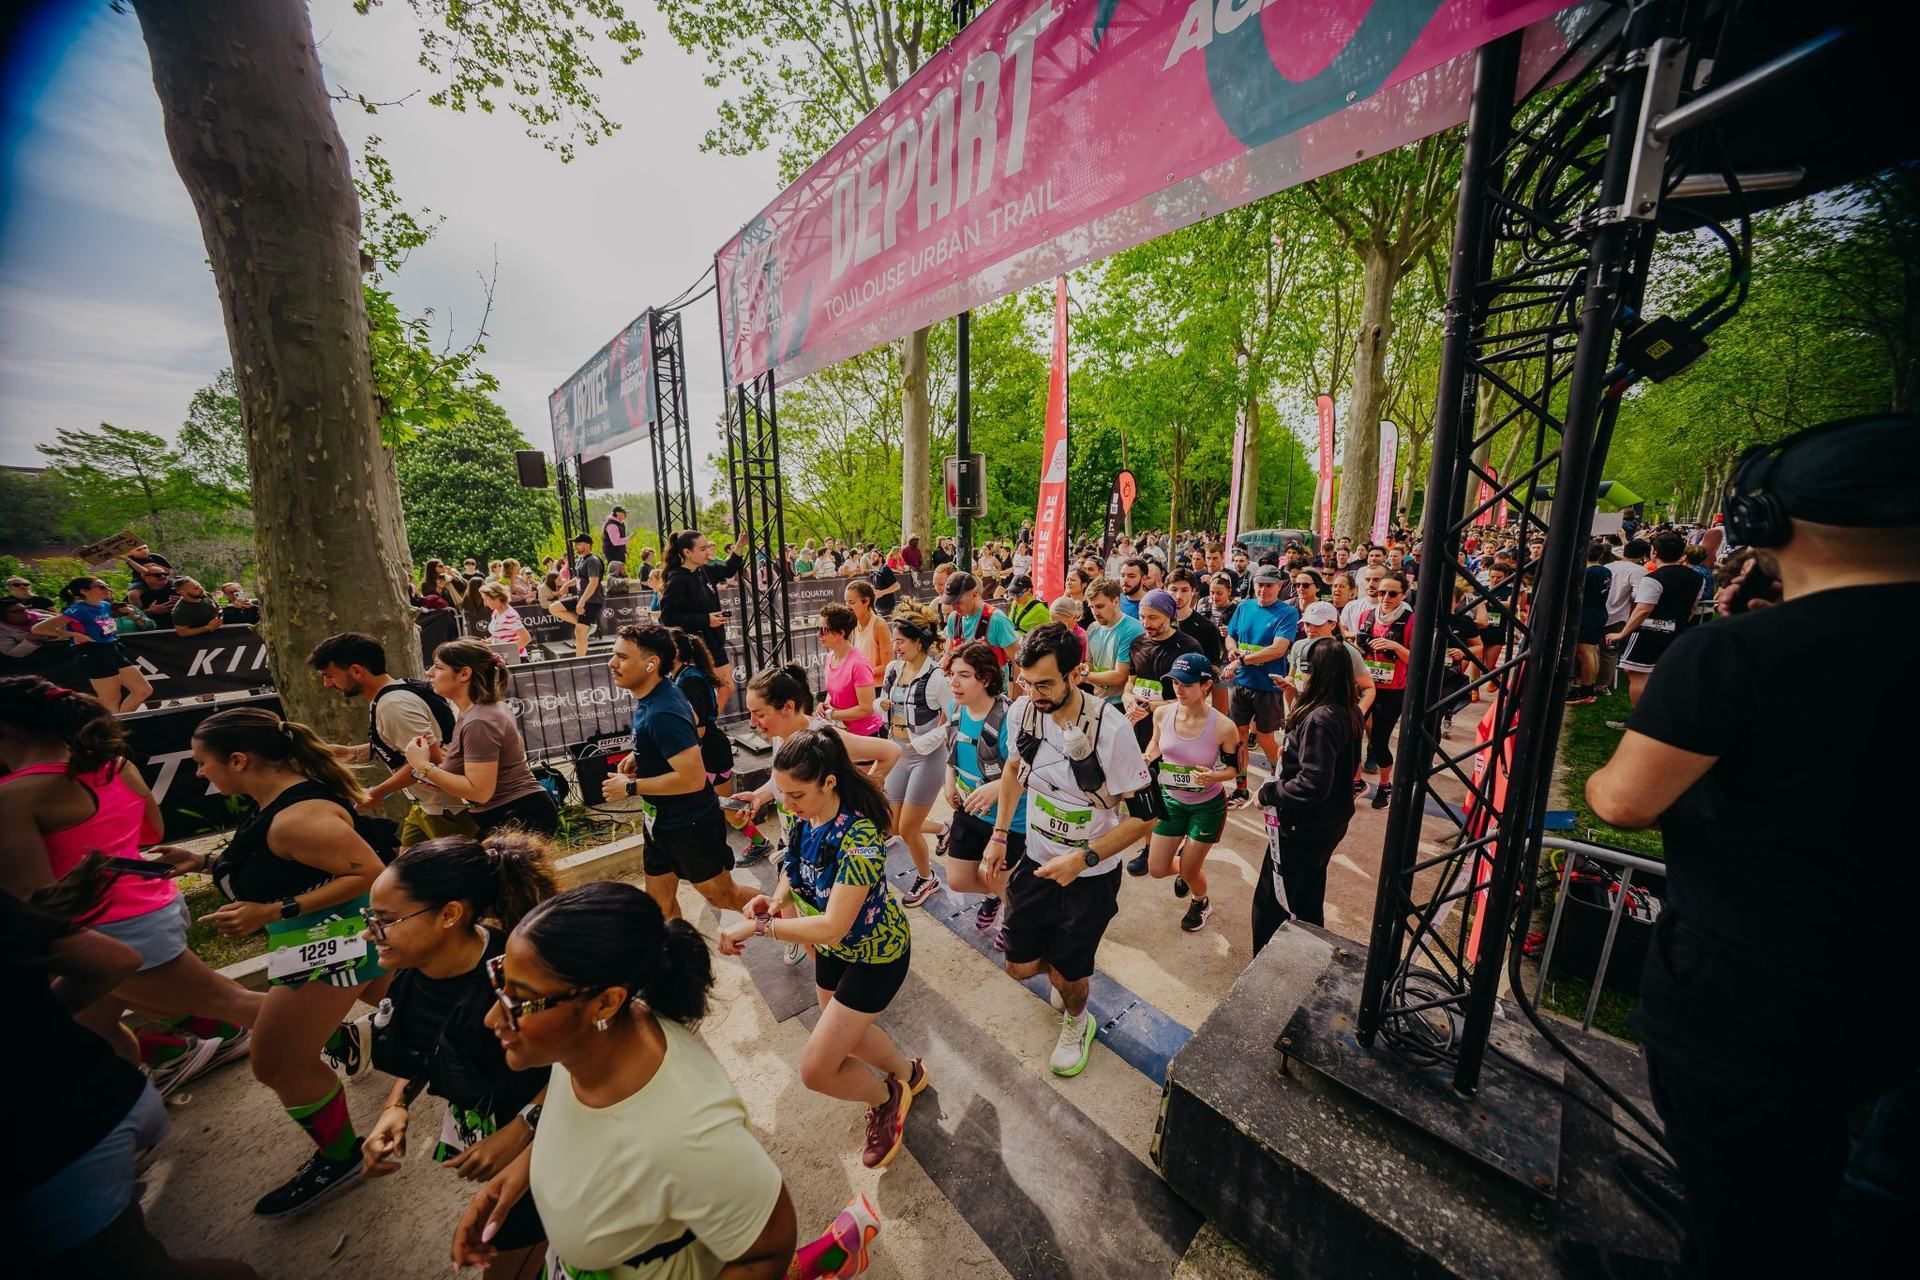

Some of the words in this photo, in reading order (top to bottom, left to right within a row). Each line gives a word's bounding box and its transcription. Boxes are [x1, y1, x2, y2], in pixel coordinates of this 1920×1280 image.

[1162, 0, 1280, 71] AG
[830, 0, 1064, 282] DEPART
[823, 261, 906, 321] TOULOUSE
[911, 219, 980, 276] URBAN
[988, 180, 1061, 239] TRAIL
[1042, 494, 1059, 523] DE
[801, 588, 834, 599] EQUATION
[1172, 773, 1191, 784] 1530
[1049, 818, 1069, 833] 670
[298, 939, 337, 963] 1229
